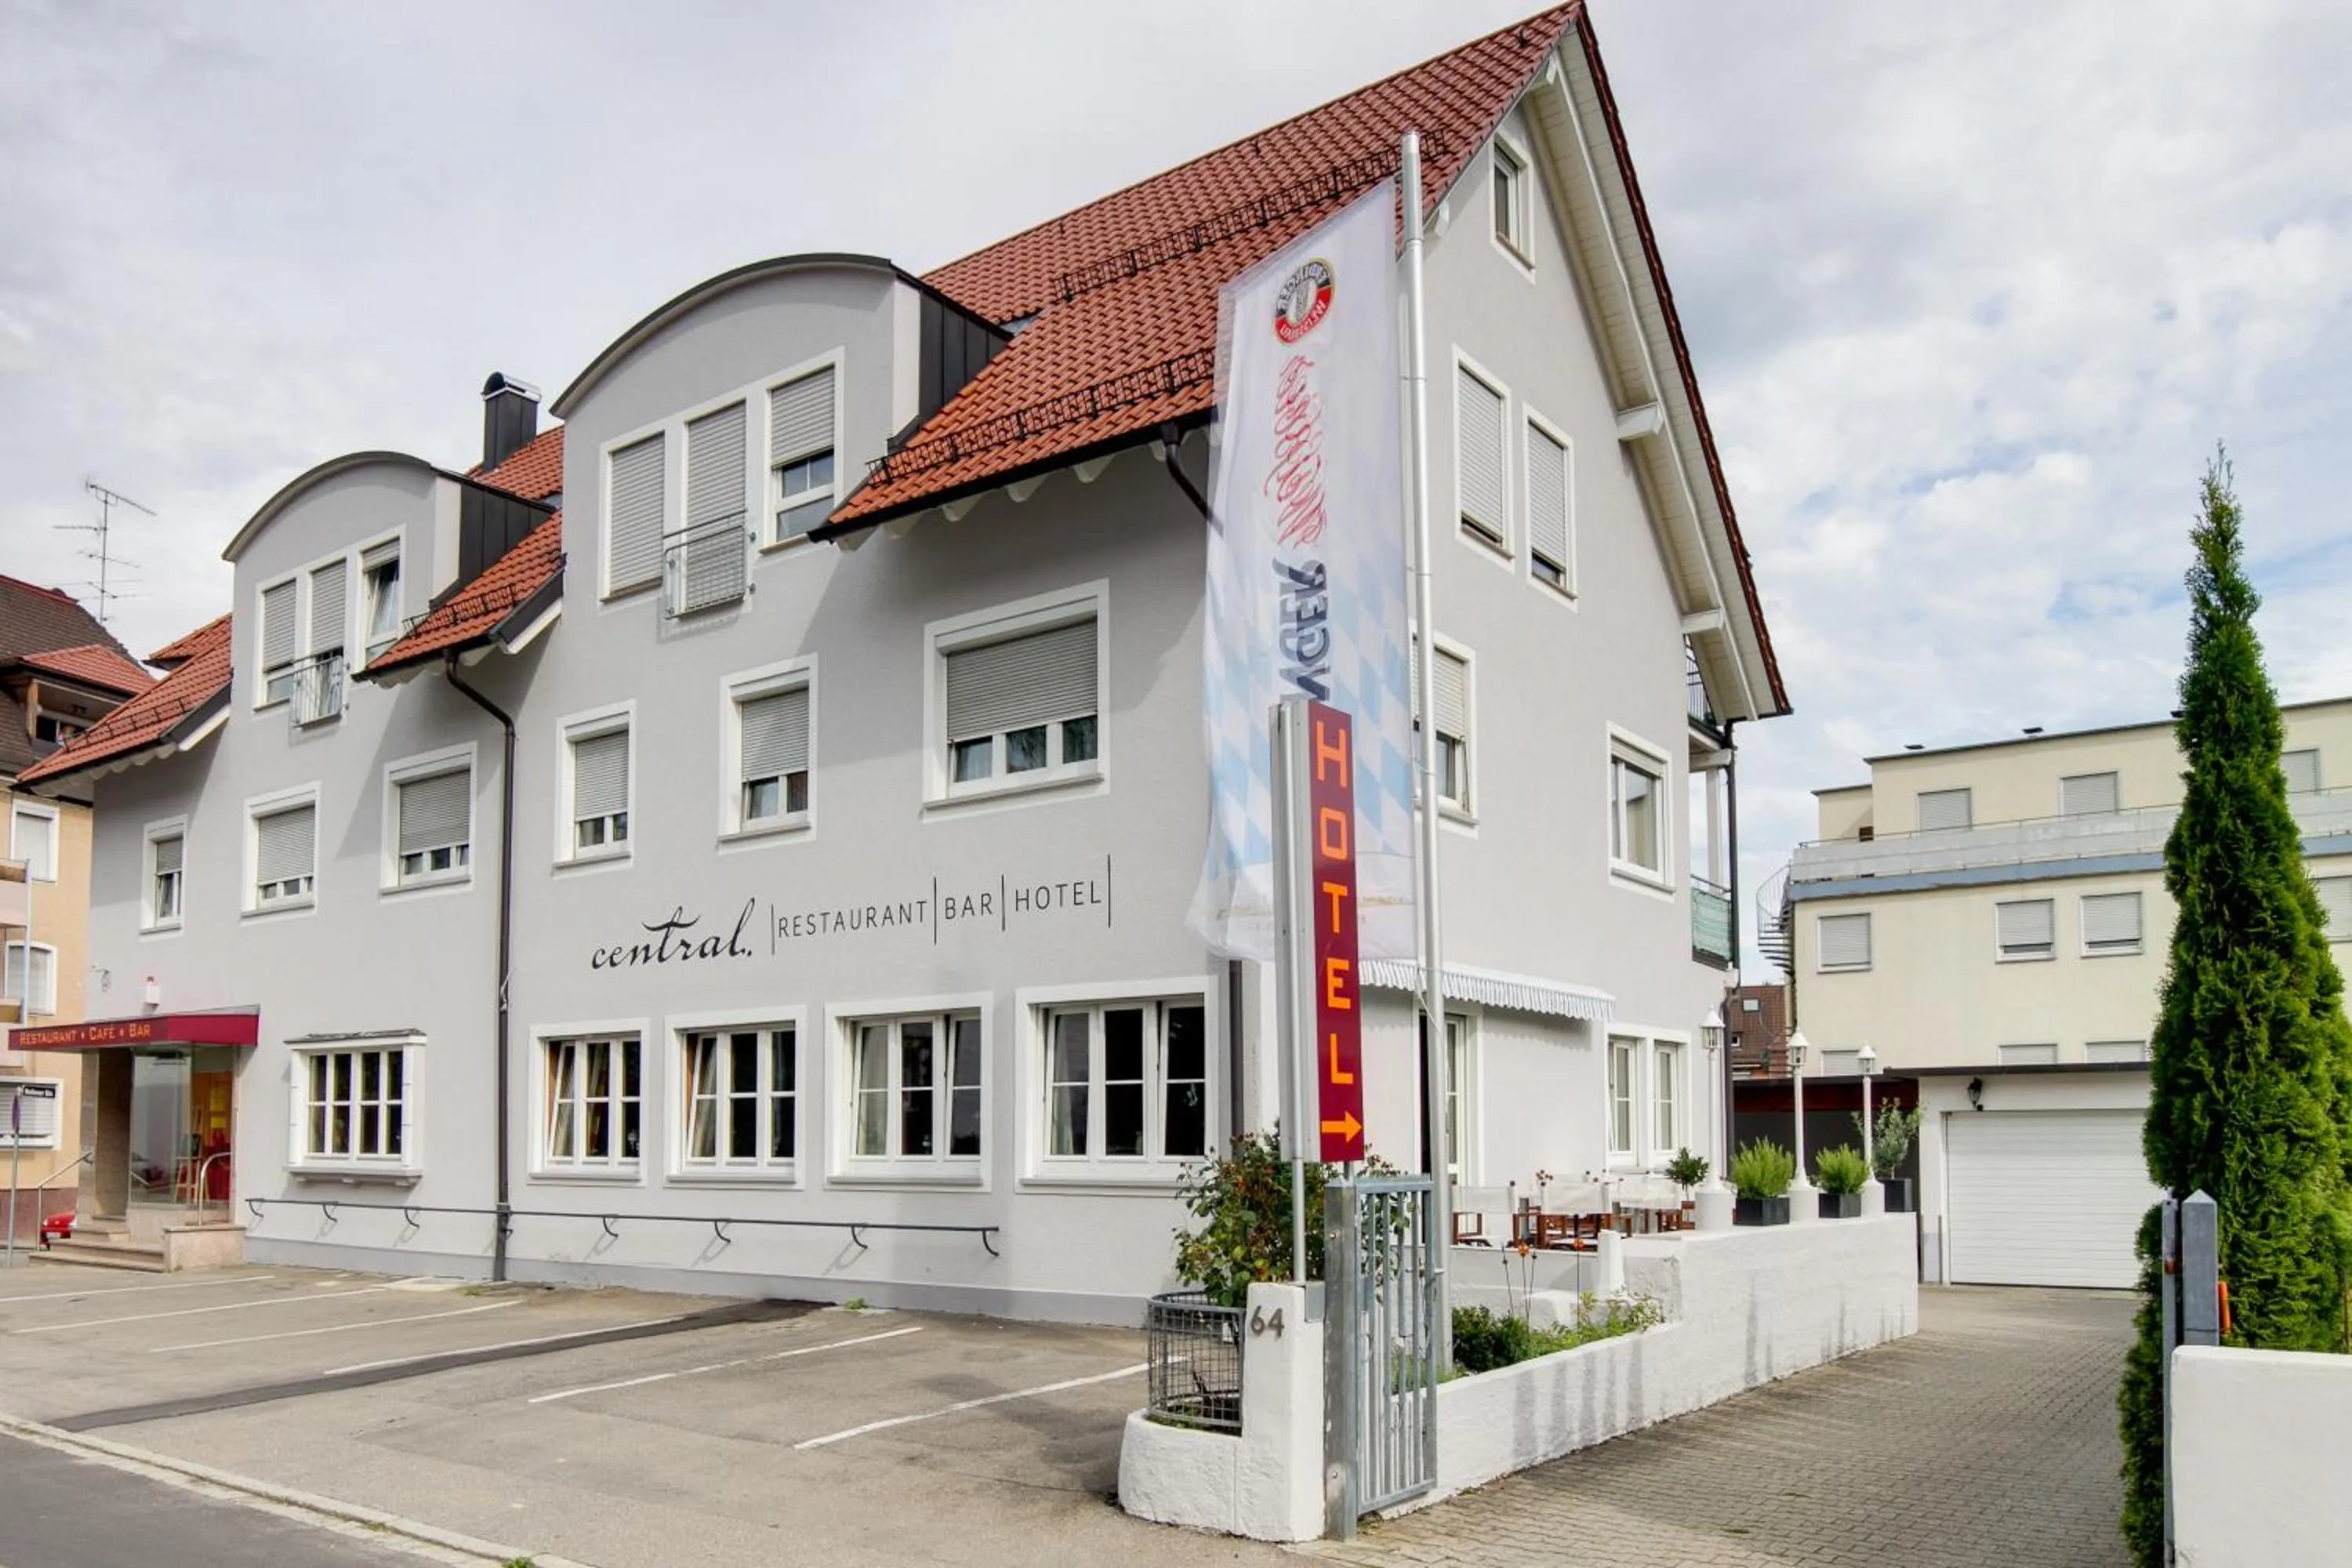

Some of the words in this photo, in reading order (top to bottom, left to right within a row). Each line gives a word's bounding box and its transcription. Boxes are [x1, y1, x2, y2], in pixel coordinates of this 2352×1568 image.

[777, 900, 928, 939] RESTAURANT
[944, 892, 994, 921] BAR
[1014, 879, 1102, 913] HOTEL
[1316, 720, 1354, 1085] HOTEL
[19, 1029, 78, 1045] RESTAURANT
[129, 1022, 151, 1038] BAR
[1250, 1305, 1285, 1338] 64
